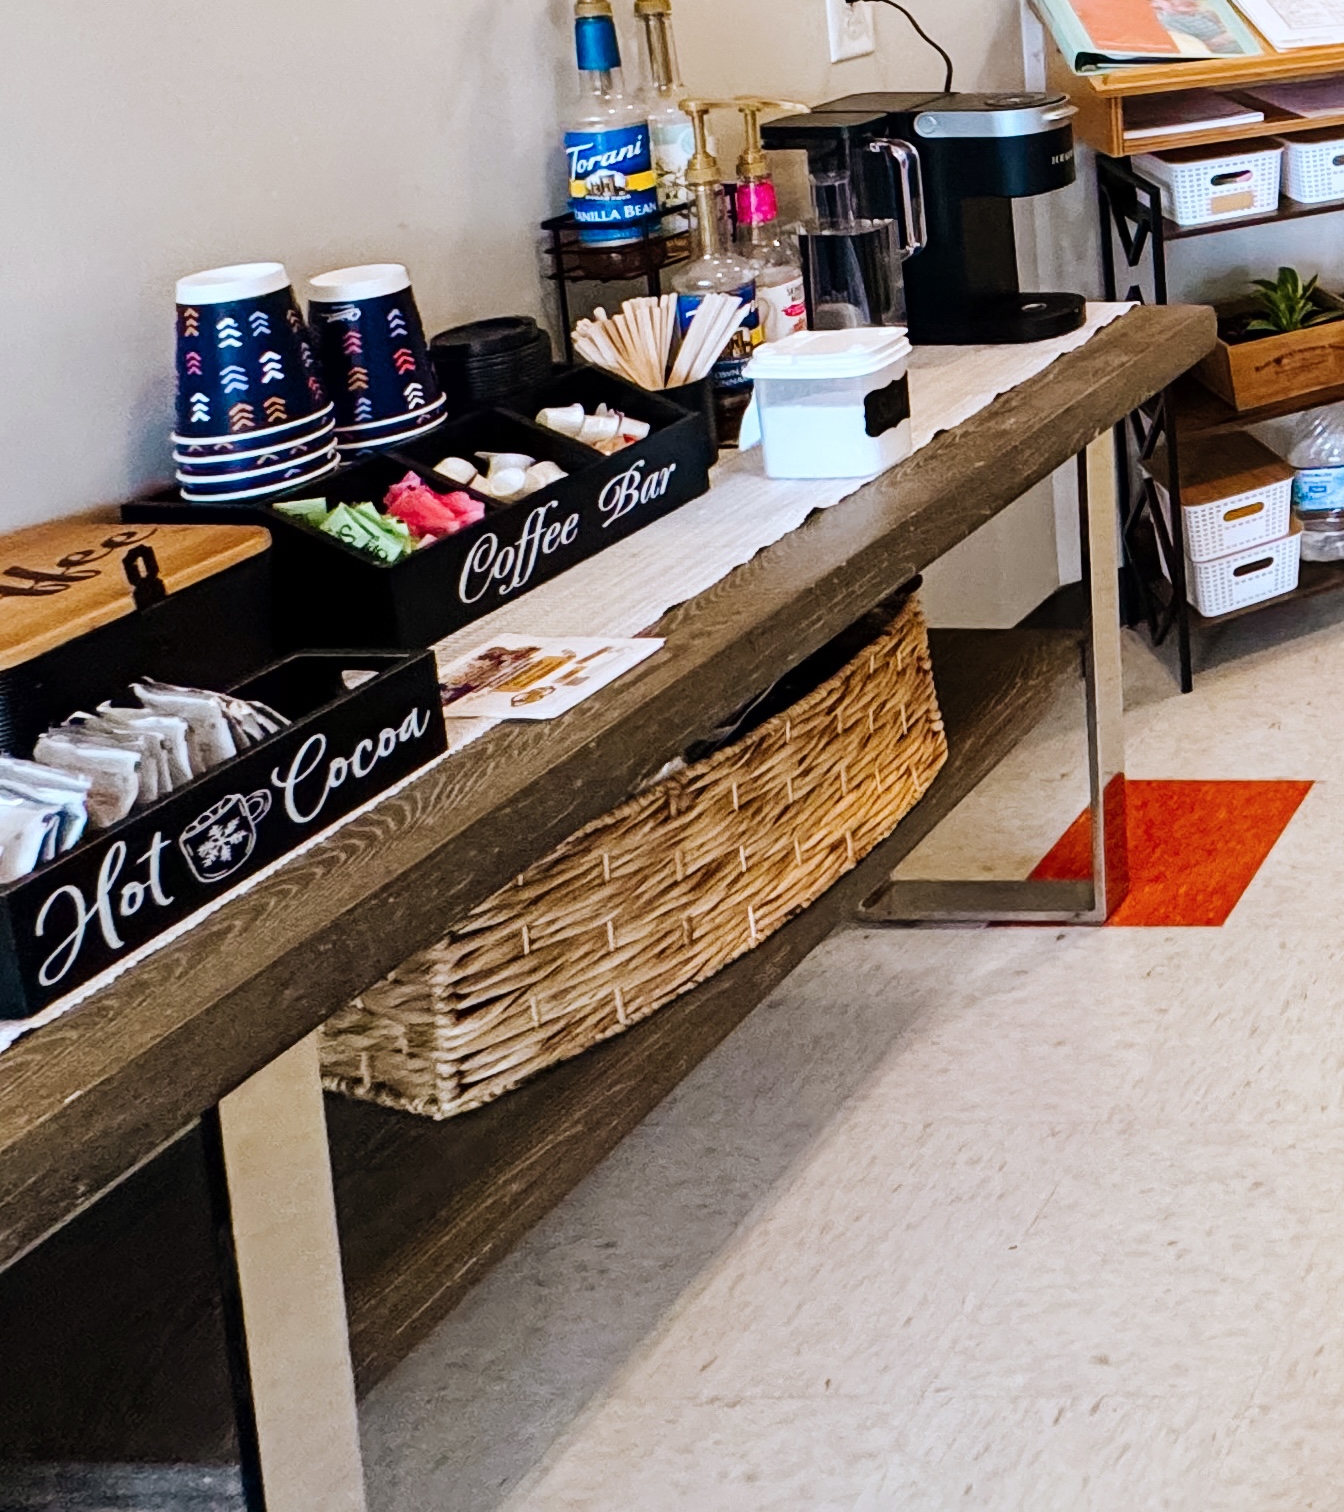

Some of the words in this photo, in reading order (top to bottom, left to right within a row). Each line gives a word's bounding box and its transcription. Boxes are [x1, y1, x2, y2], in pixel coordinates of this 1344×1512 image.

[565, 134, 643, 182] Torani
[573, 209, 622, 222] ANILLA
[458, 500, 580, 606] Coffee
[598, 459, 678, 529] Bar
[34, 831, 175, 988] Hot
[271, 705, 432, 825] Cocoa
